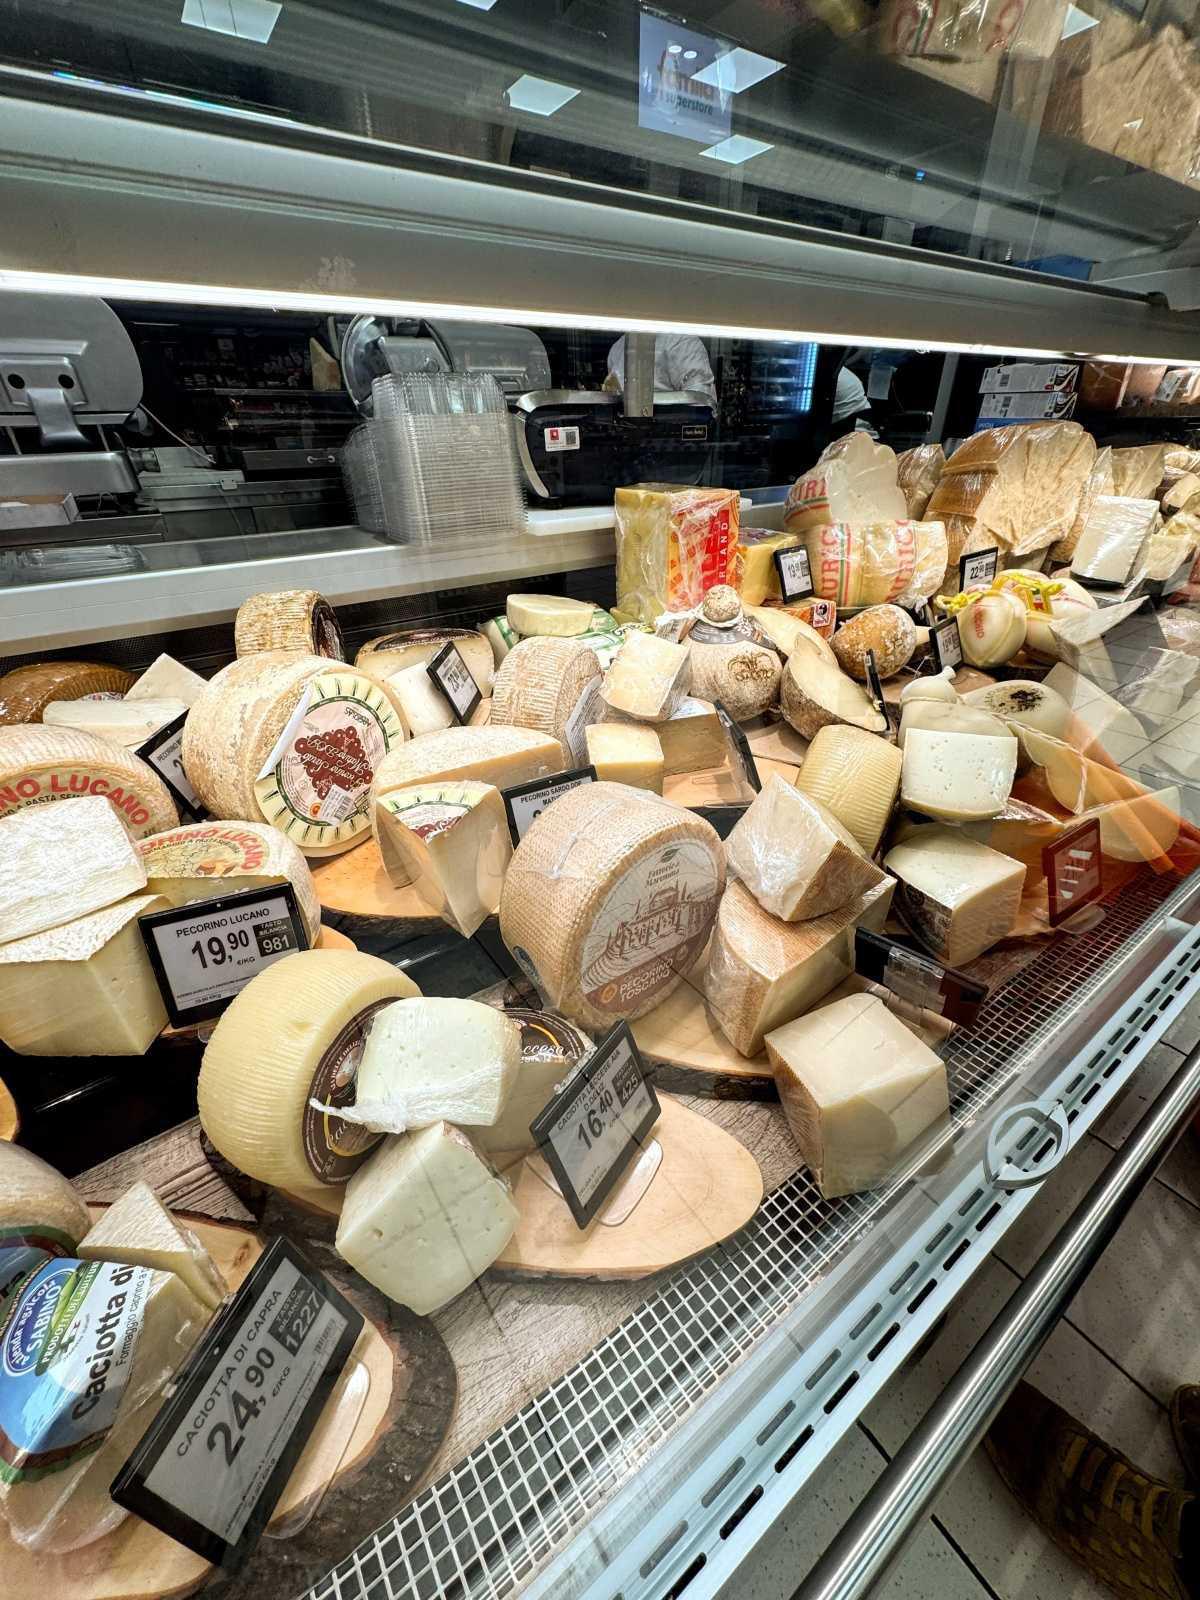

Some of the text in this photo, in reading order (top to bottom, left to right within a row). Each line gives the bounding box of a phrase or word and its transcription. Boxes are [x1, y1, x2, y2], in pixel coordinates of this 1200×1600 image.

[25, 794, 56, 806] PASTA
[51, 773, 150, 825] LUCANO
[520, 790, 549, 803] PECORINO
[551, 784, 570, 795] SARDO
[176, 908, 270, 937] PECORINO LUCANO
[262, 934, 290, 953] 981
[620, 959, 673, 994] PECORINO
[621, 968, 670, 1003] TOSCANO
[622, 1073, 639, 1101] 425
[557, 1092, 587, 1130] CACIOTTA
[28, 1284, 62, 1352] SABINO
[284, 1291, 322, 1350] 1227
[71, 1290, 128, 1421] Caciotta
[115, 1313, 138, 1368] Formaggio
[176, 1365, 237, 1458] CACIOTTA
[234, 1343, 249, 1364] DI
[246, 1289, 282, 1342] CAPRA
